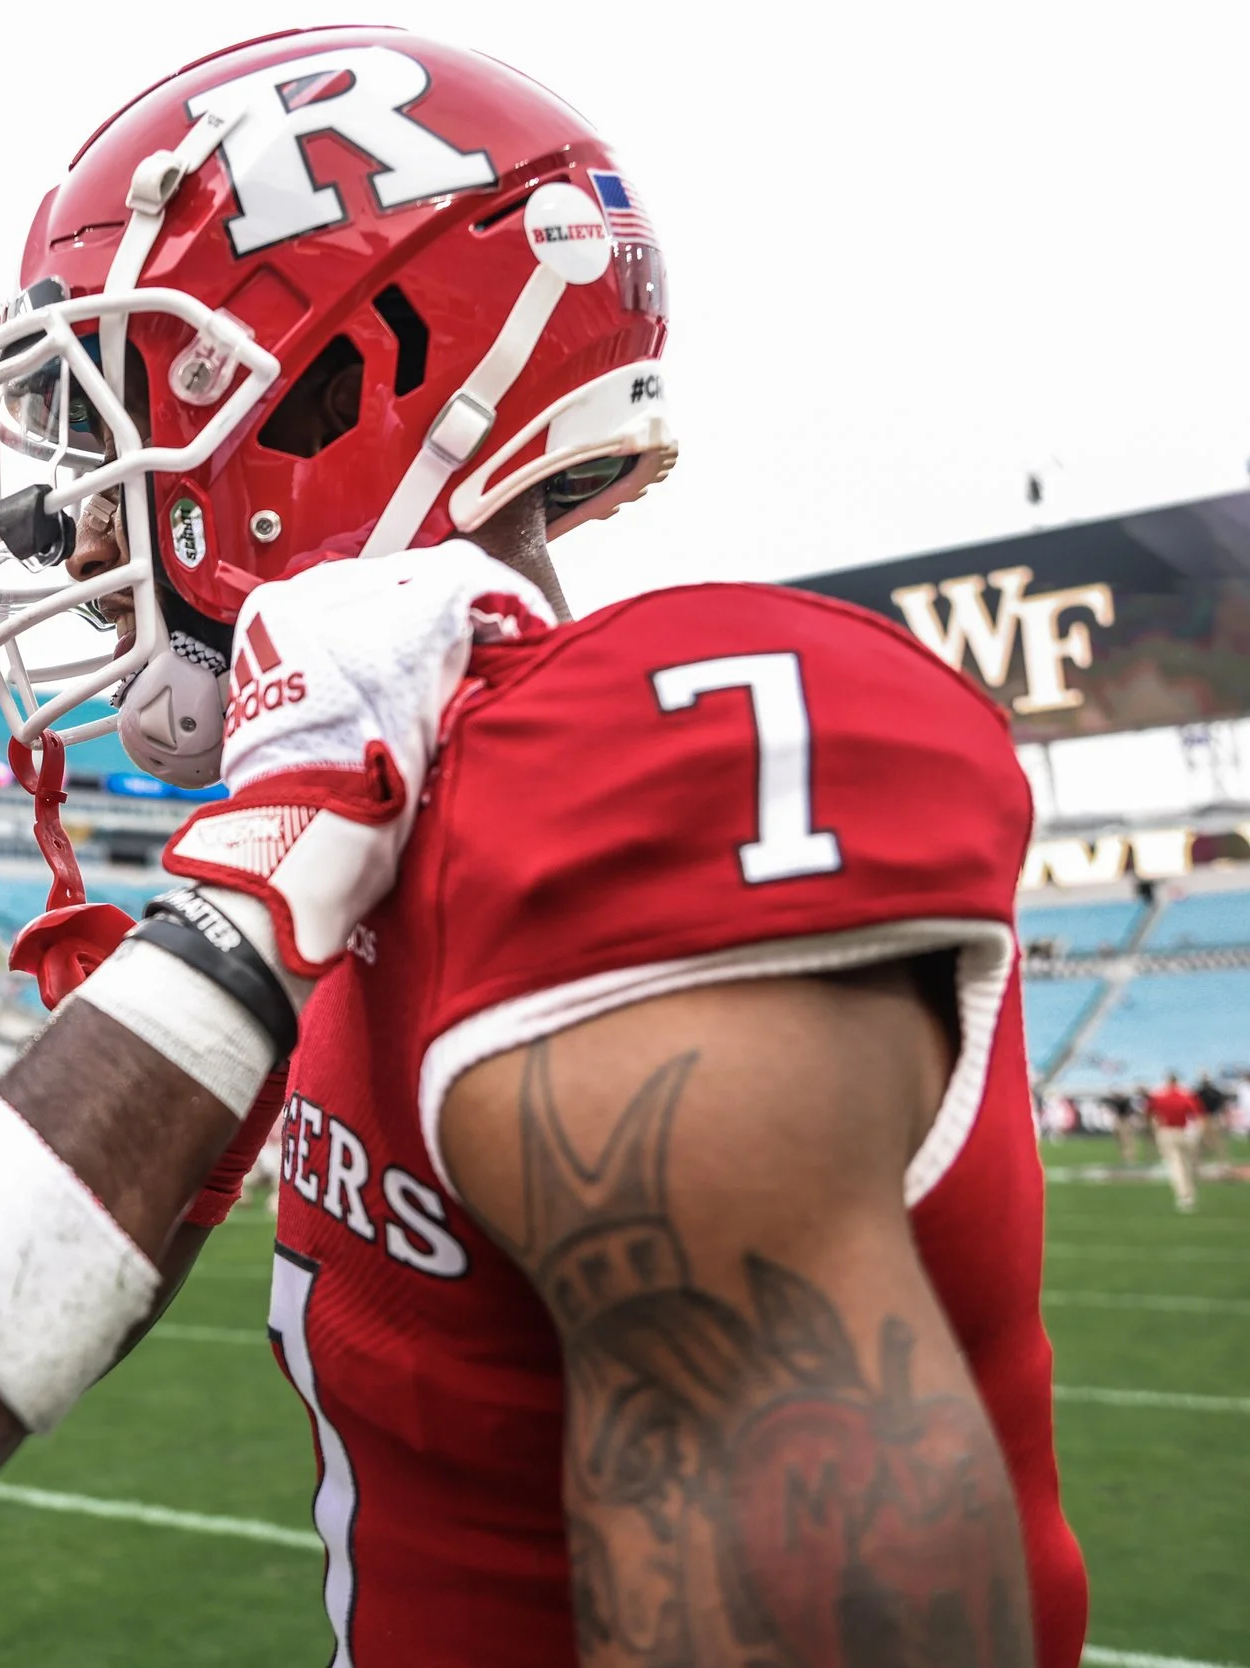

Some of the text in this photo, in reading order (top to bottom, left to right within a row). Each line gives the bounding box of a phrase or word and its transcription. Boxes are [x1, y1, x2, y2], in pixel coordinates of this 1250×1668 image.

[183, 45, 499, 261] R
[532, 223, 606, 245] BELIEVE
[891, 565, 1115, 714] WF
[648, 649, 843, 888] 7
